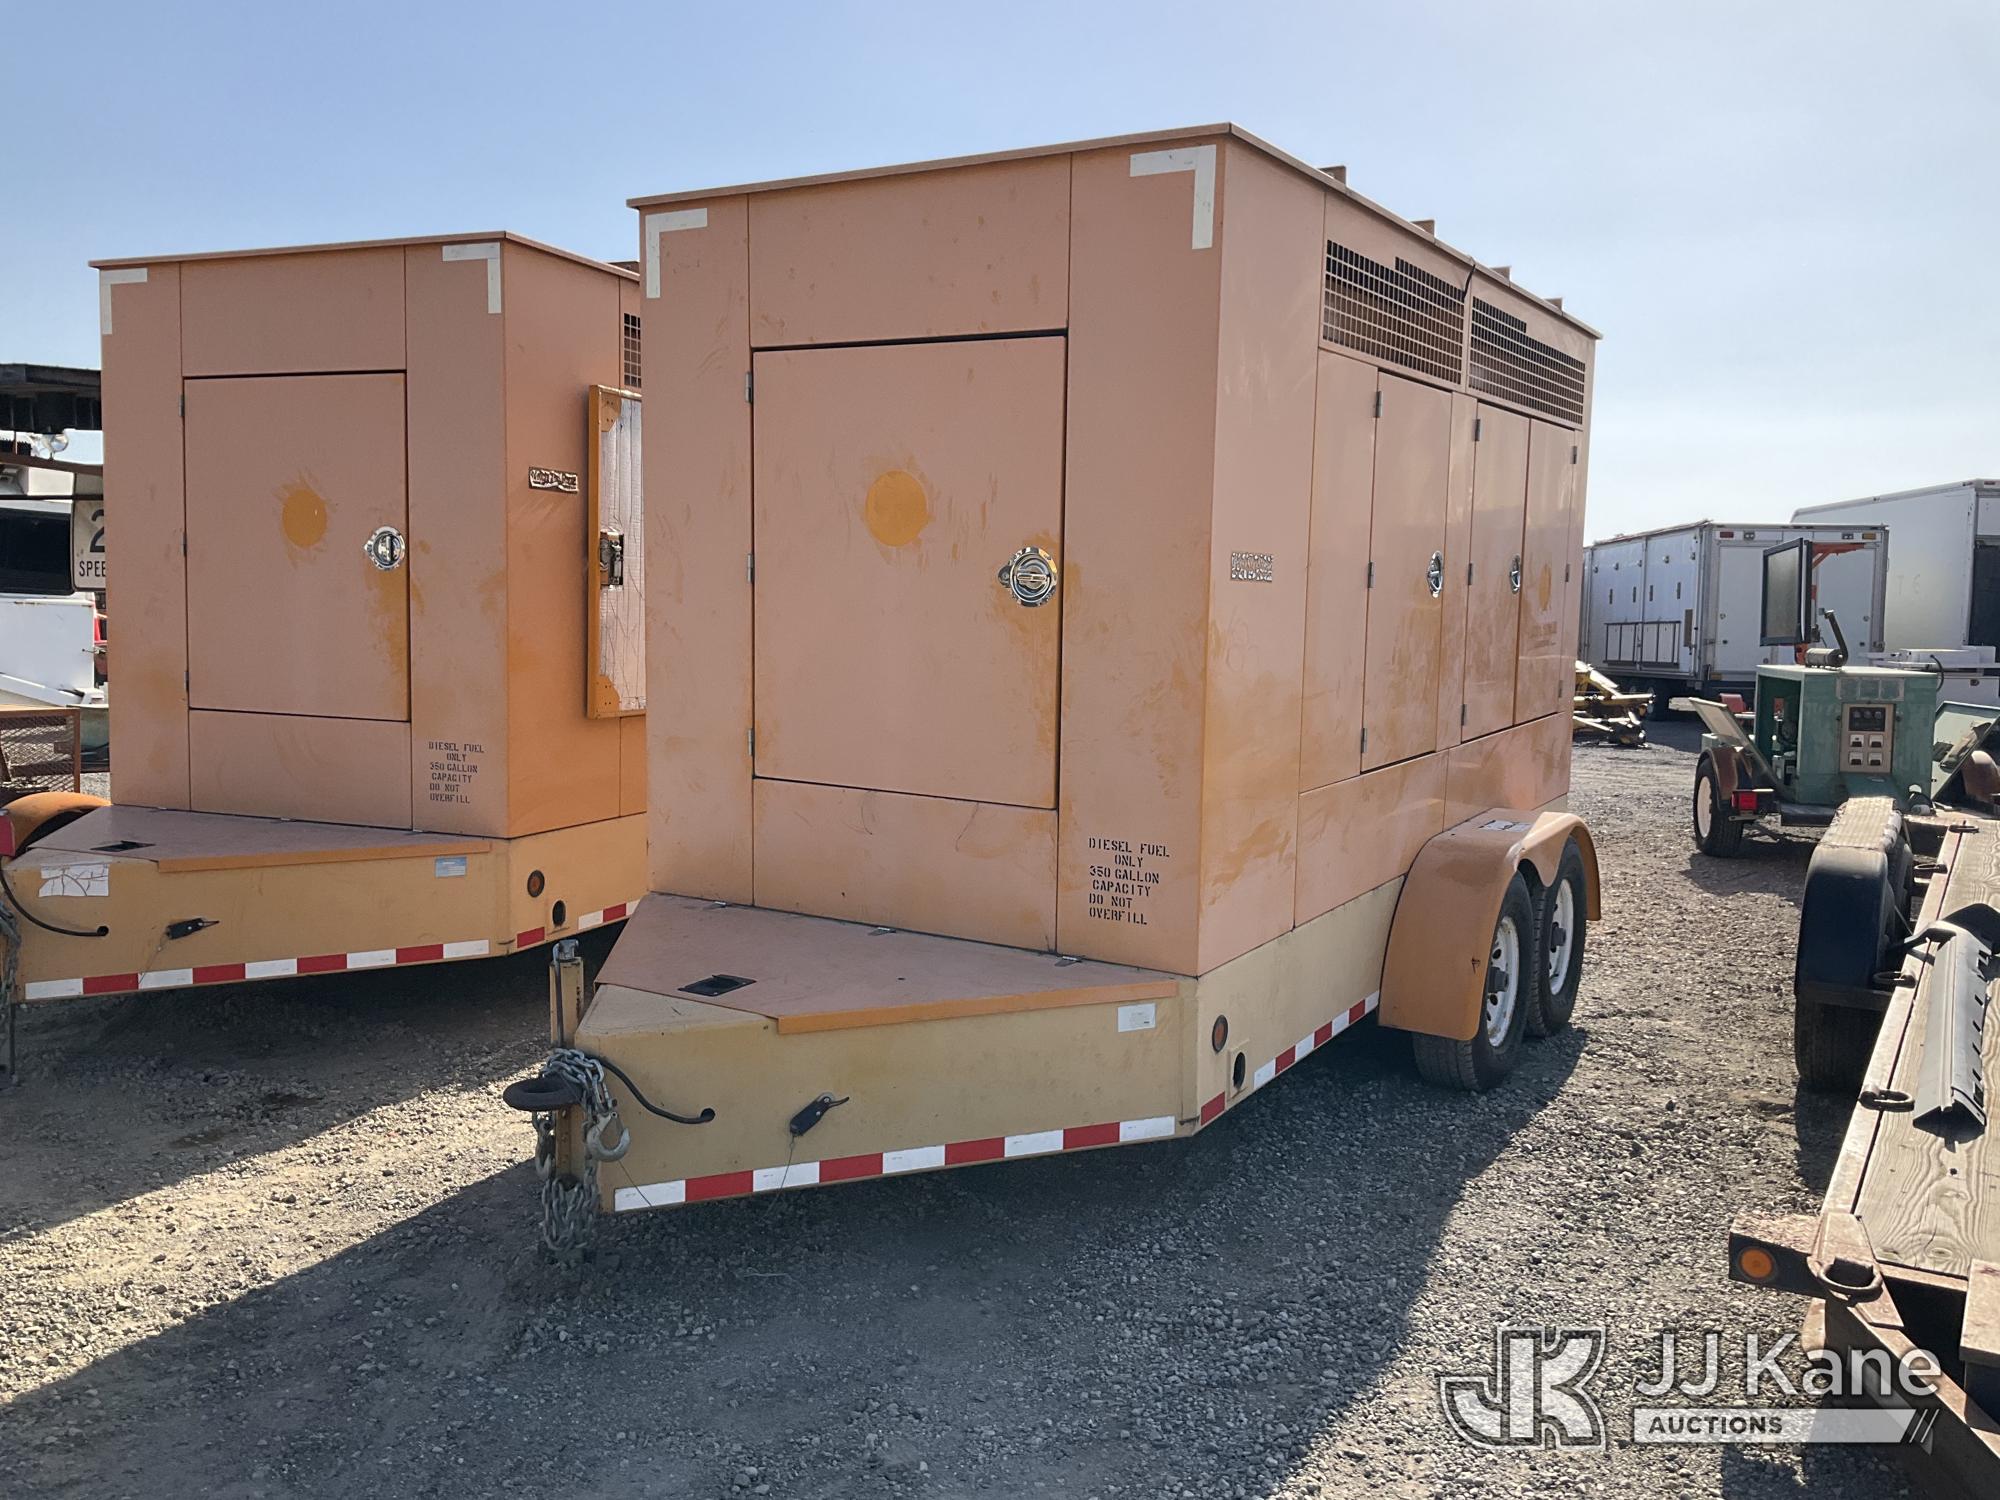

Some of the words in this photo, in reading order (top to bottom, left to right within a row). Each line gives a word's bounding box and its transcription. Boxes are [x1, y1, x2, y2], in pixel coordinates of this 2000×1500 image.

[428, 741, 459, 752] DIESEL
[464, 743, 485, 753] FUEL
[446, 753, 467, 762] ONLY
[429, 762, 445, 771] 350
[446, 763, 478, 773] GALLON
[431, 772, 473, 783] CAPACITY
[429, 783, 440, 791] DO
[444, 784, 460, 793] NOT
[429, 793, 471, 804] OVERFILL
[1088, 837, 1132, 853] DIESEL
[1140, 843, 1170, 858] FUEL
[1114, 854, 1143, 868] ONLY
[1089, 865, 1111, 878] 350
[1115, 868, 1160, 884] GALLON
[1092, 879, 1151, 897] CAPACITY
[1088, 893, 1104, 905] DO
[1111, 896, 1132, 909] NOT
[1088, 907, 1148, 925] OVERFILL
